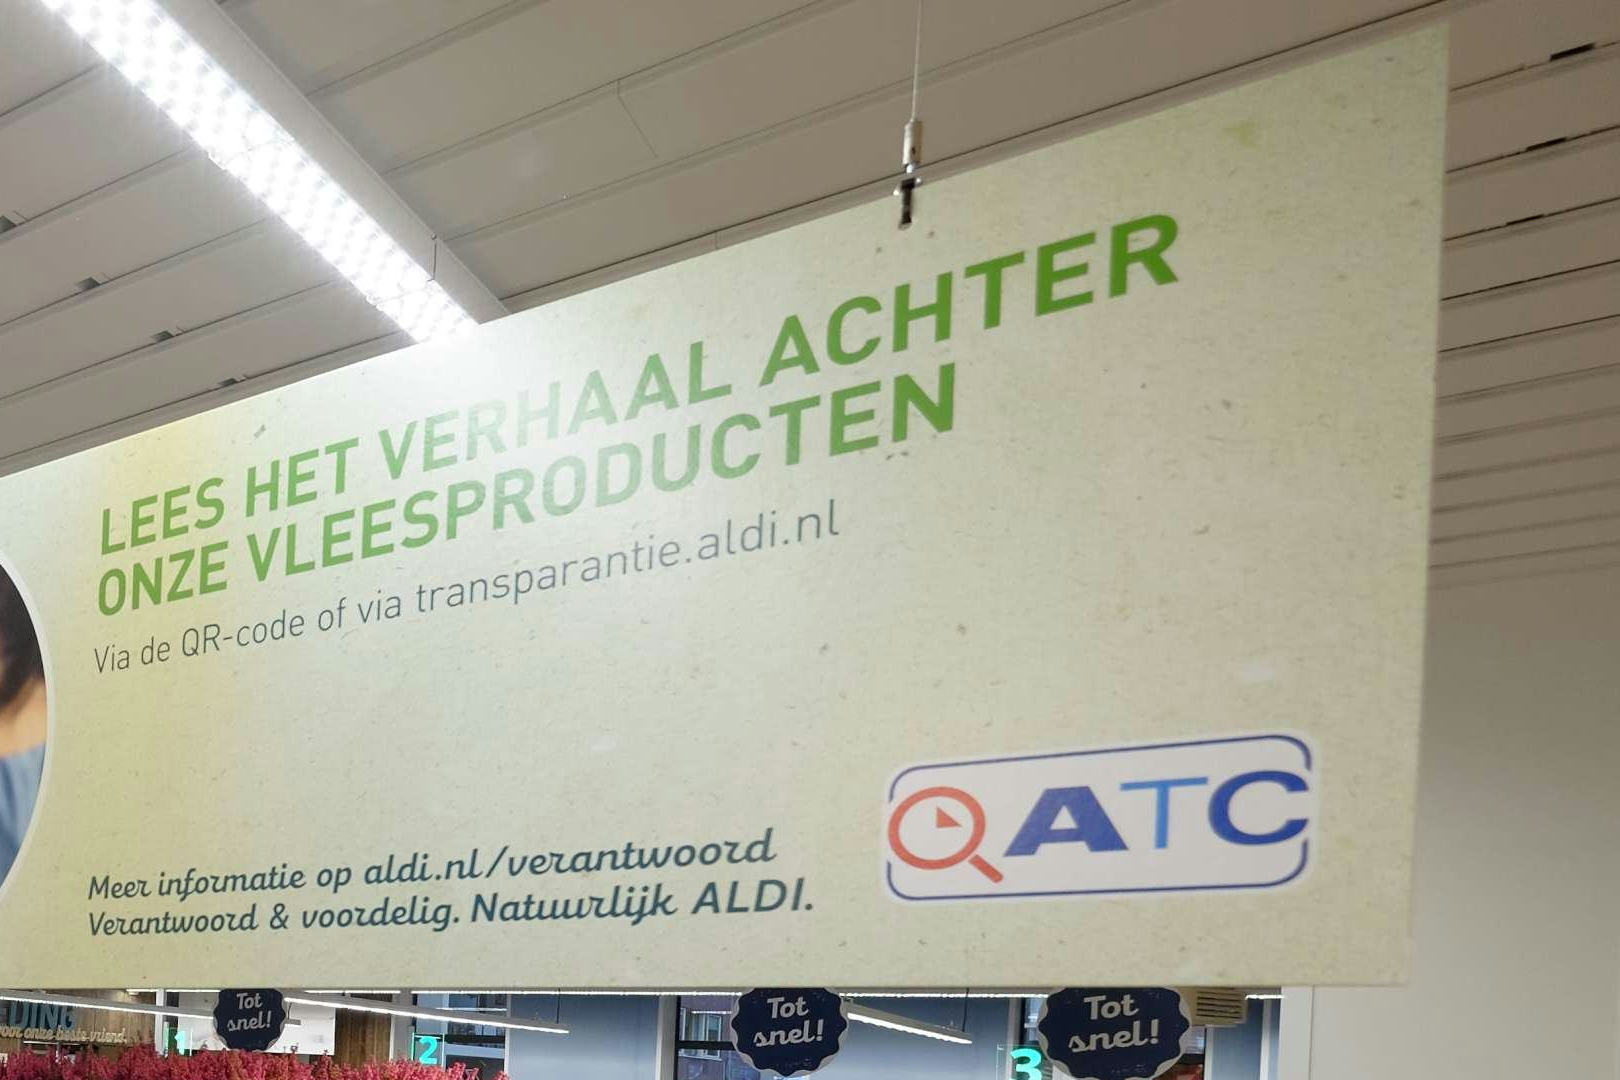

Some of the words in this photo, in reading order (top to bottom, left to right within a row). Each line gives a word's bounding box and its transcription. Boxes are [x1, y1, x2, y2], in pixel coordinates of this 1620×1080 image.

[100, 476, 226, 557] LEES
[245, 434, 362, 518] HET
[379, 341, 733, 481] VERHAAL
[759, 213, 1181, 388] ACHTER
[98, 538, 230, 617] ONZE
[246, 362, 957, 584] VLEESPRODUCTEN
[93, 643, 131, 675] Via
[140, 635, 172, 667] de
[181, 607, 306, 658] QR-code
[317, 596, 349, 632] of
[357, 592, 402, 625] via
[416, 497, 841, 615] transparantie.aldi.nl
[88, 874, 153, 901] Meer
[158, 863, 308, 904] informatie
[315, 866, 353, 895] op
[364, 826, 778, 887] aldi.nl/verantwoord
[89, 902, 261, 937] Verantwoord
[270, 902, 290, 932] &
[302, 893, 461, 934] voordelig.
[470, 880, 680, 927] Natuurlijk
[690, 876, 816, 916] ALDI.
[236, 991, 263, 1010] Tot
[767, 996, 809, 1019] Tot
[1082, 995, 1139, 1021] Tot
[227, 1011, 272, 1033] snel!
[753, 1019, 823, 1048] snel!
[1068, 1019, 1159, 1053] snel!
[417, 1035, 438, 1065] 2
